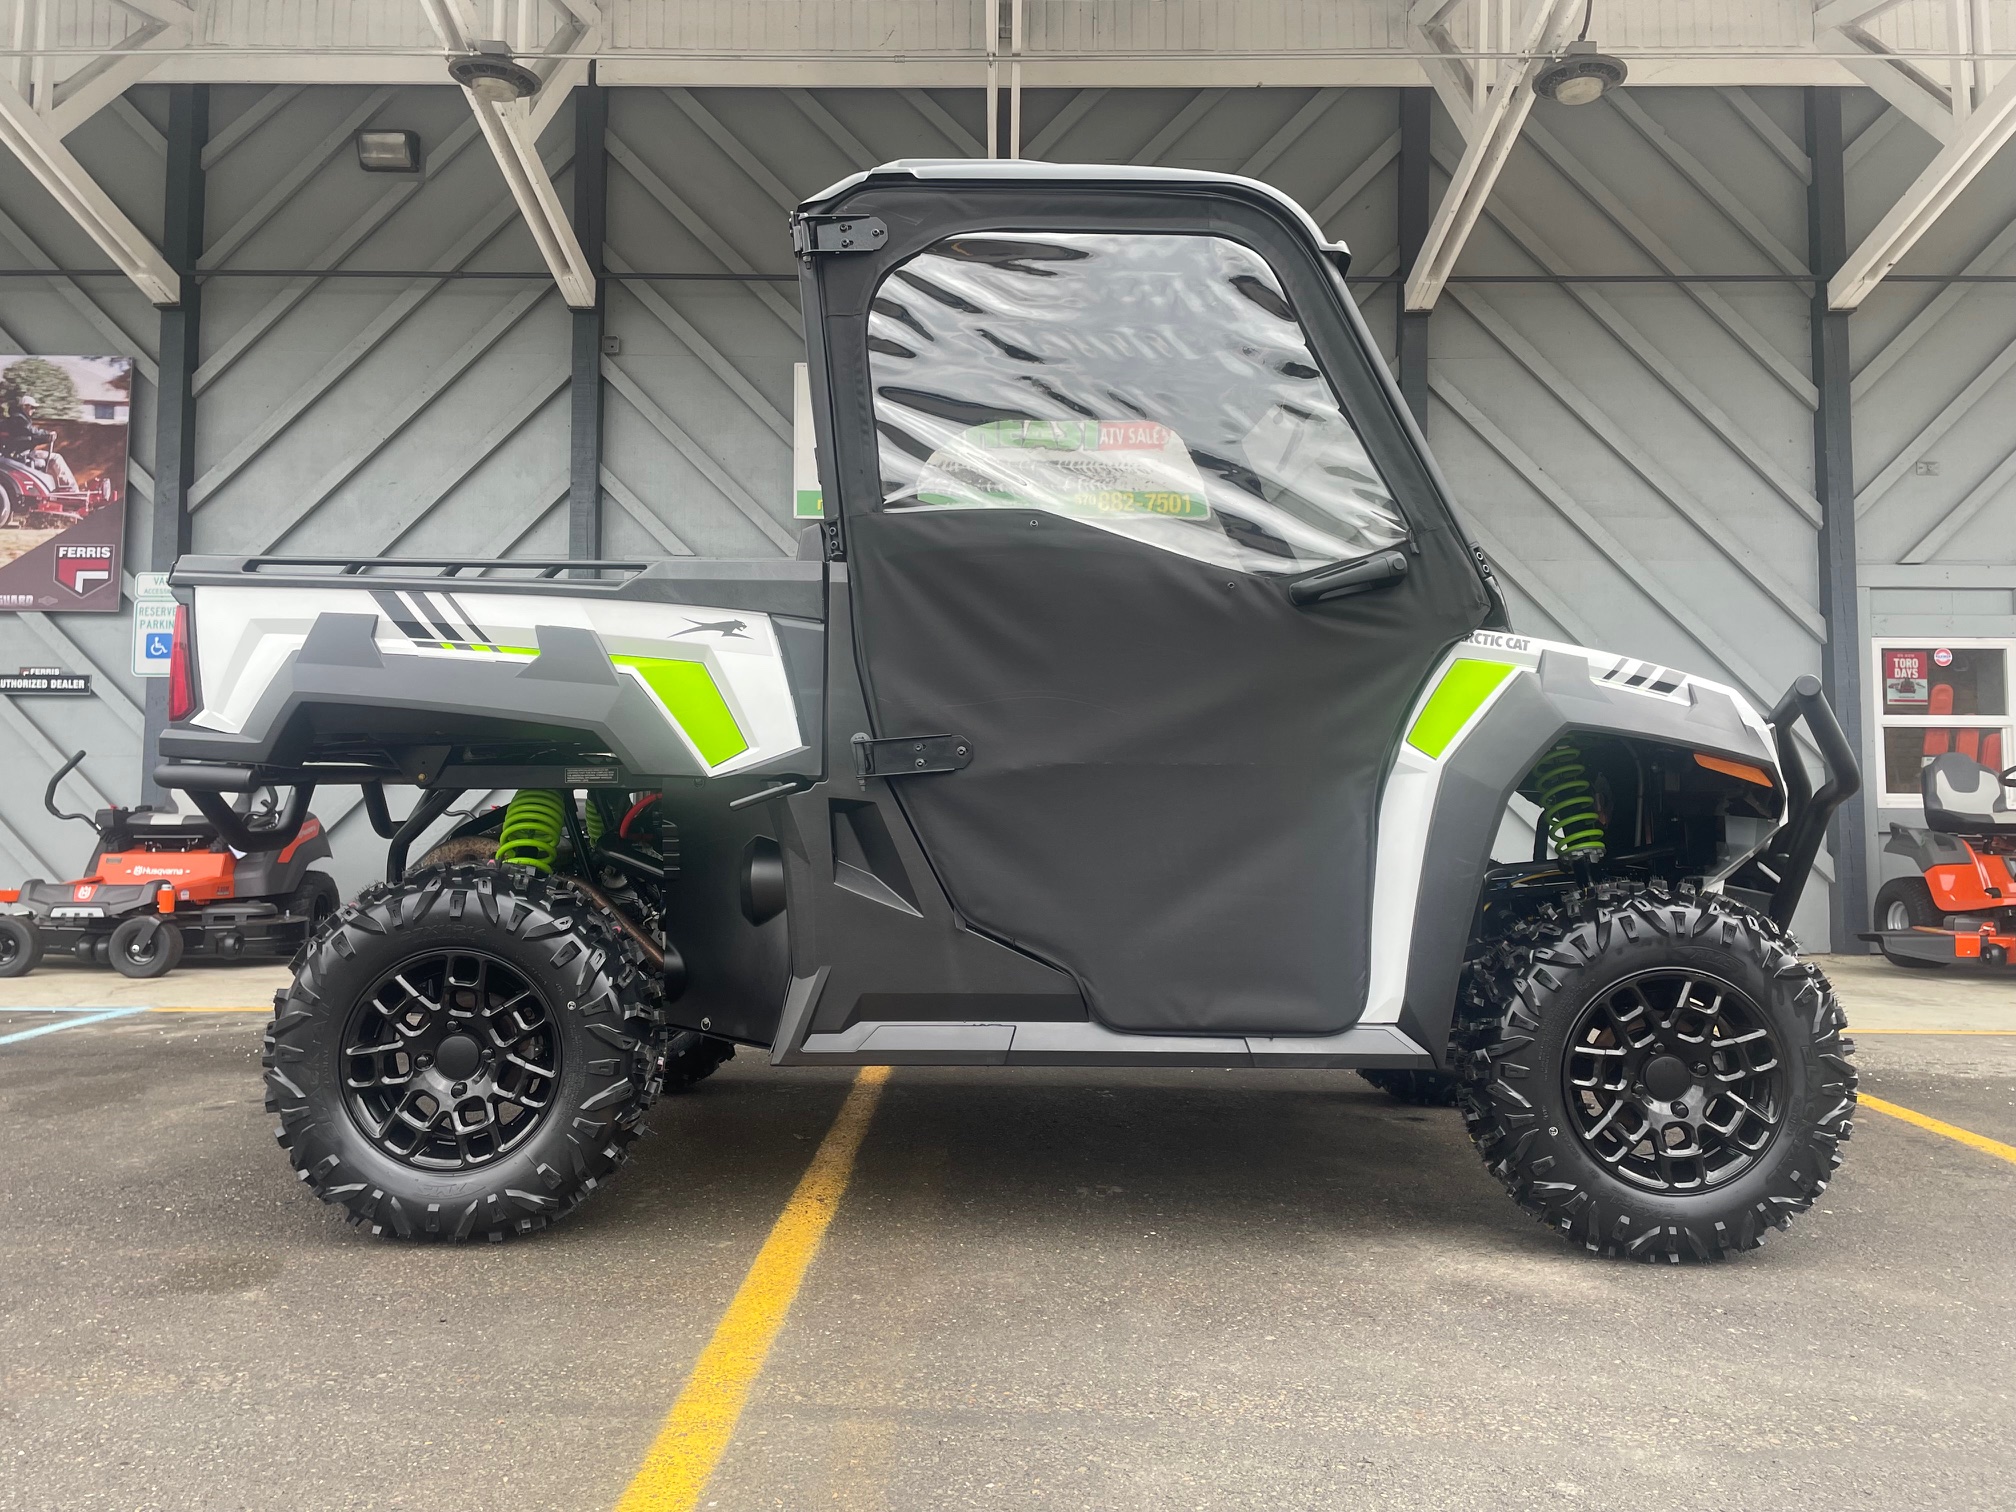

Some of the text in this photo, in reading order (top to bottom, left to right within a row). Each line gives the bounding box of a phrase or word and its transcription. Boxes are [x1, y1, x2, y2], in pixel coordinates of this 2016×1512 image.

[1100, 427, 1170, 446] ATV SALES
[59, 546, 111, 558] FERRIS
[1505, 637, 1531, 651] CAT
[1893, 658, 1918, 668] TORO
[30, 668, 60, 676] FERRIS
[1894, 668, 1918, 678] DAYS
[0, 678, 48, 689] UTHORIZED
[50, 678, 85, 689] DEALER
[142, 865, 184, 876] Husqvarna
